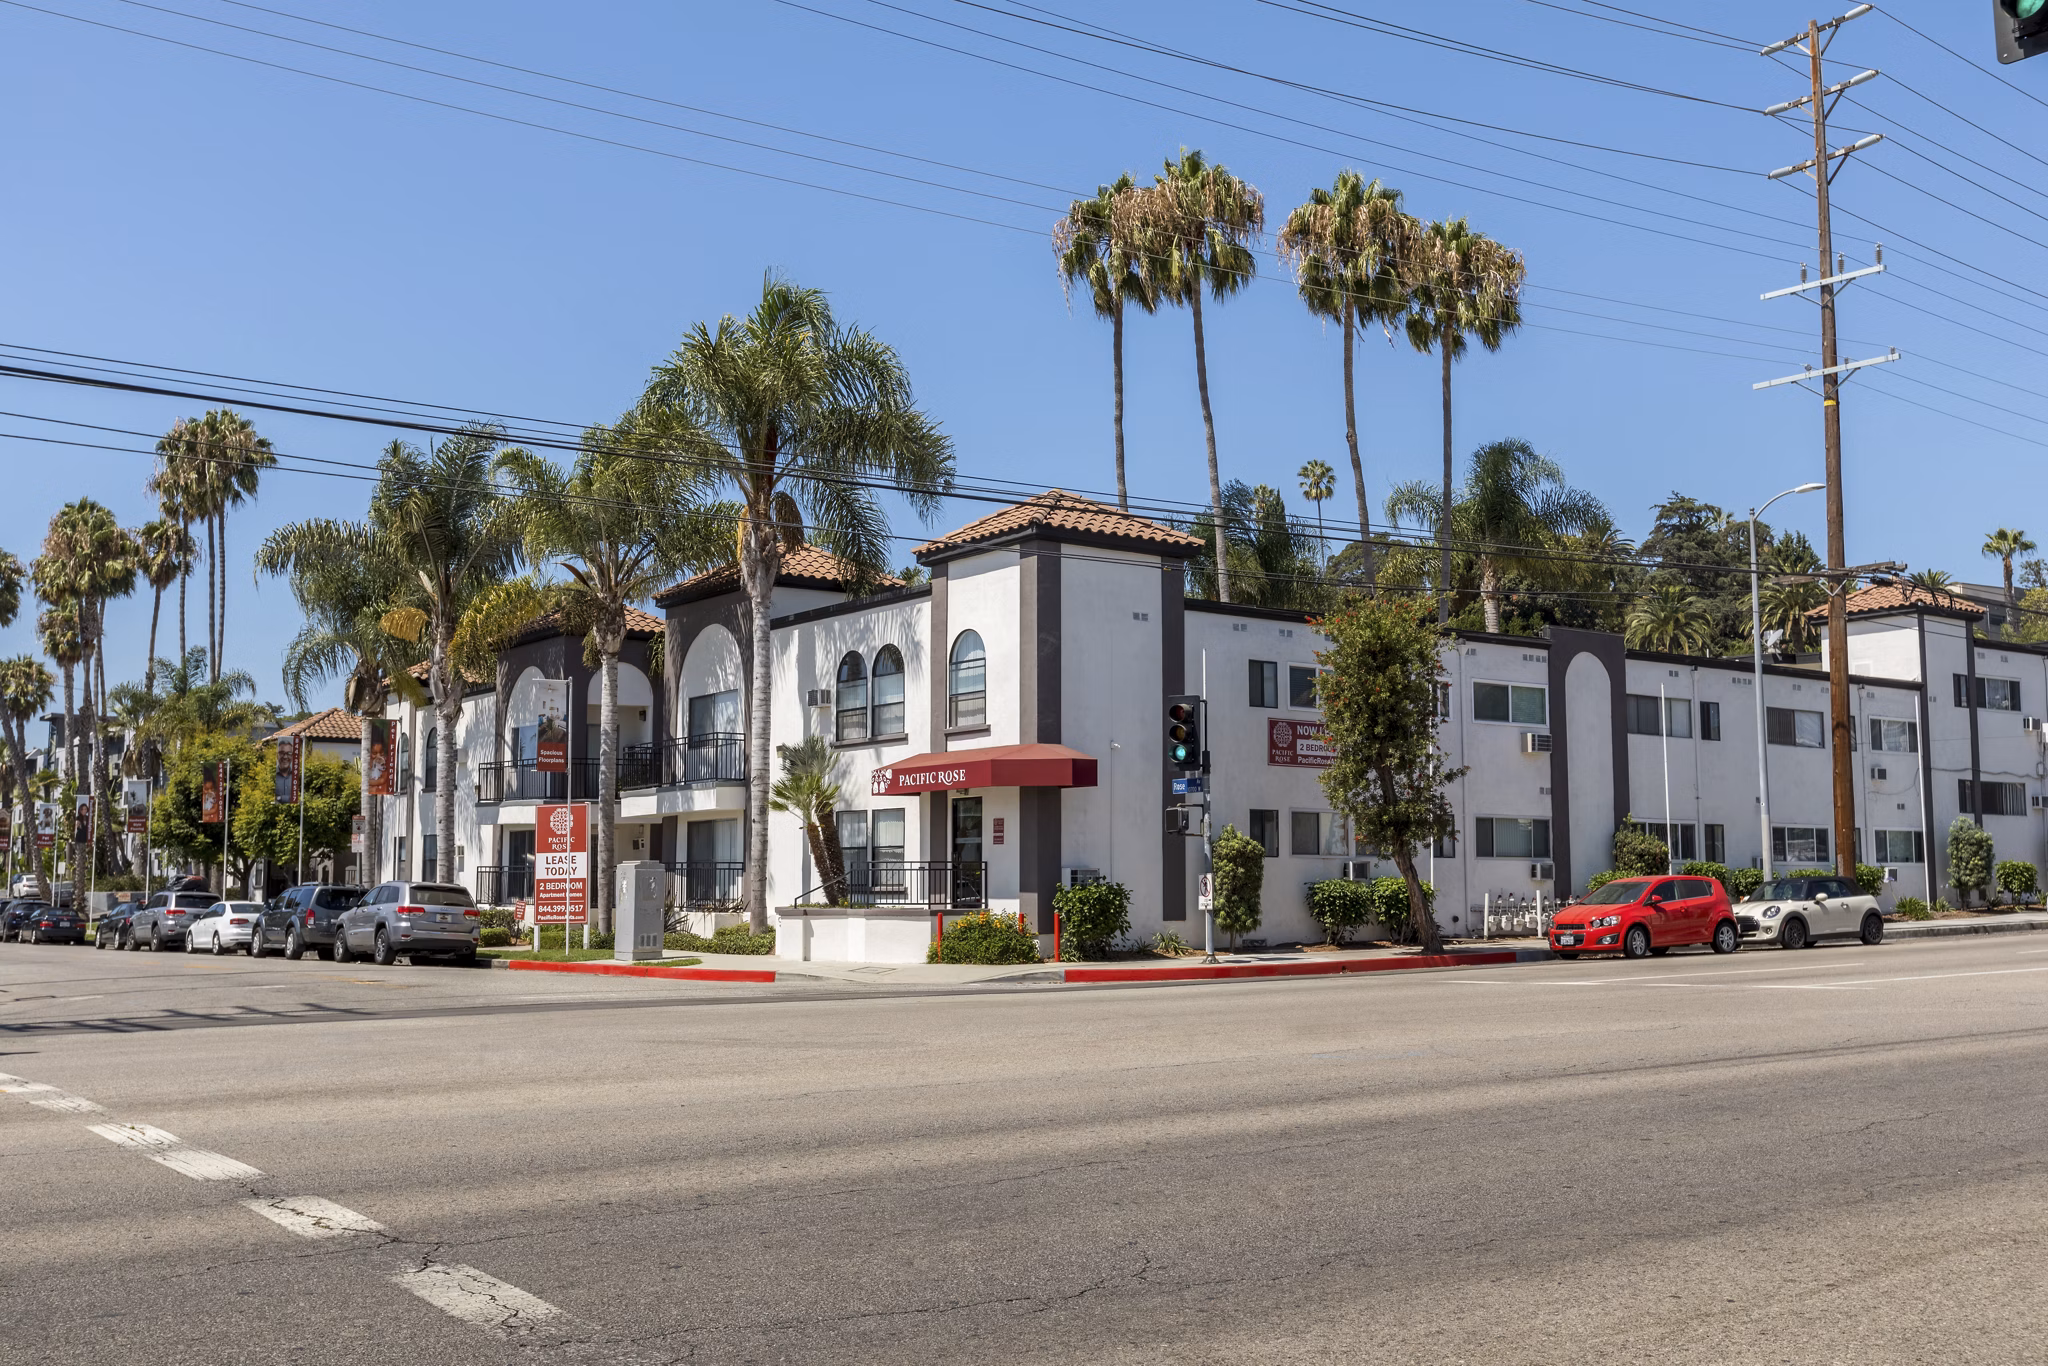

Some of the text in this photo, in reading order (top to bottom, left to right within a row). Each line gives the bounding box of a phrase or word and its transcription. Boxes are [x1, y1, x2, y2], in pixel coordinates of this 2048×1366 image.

[1297, 725, 1317, 736] NOW
[1300, 743, 1335, 752] 2 BEDRO
[899, 769, 966, 786] PACIFIC ROSE
[1173, 782, 1186, 791] Rose
[548, 836, 576, 844] PACIFC
[552, 843, 572, 851] ROS
[545, 855, 577, 865] LEASE
[539, 882, 545, 890] 2
[538, 904, 584, 913] 844.399.517
